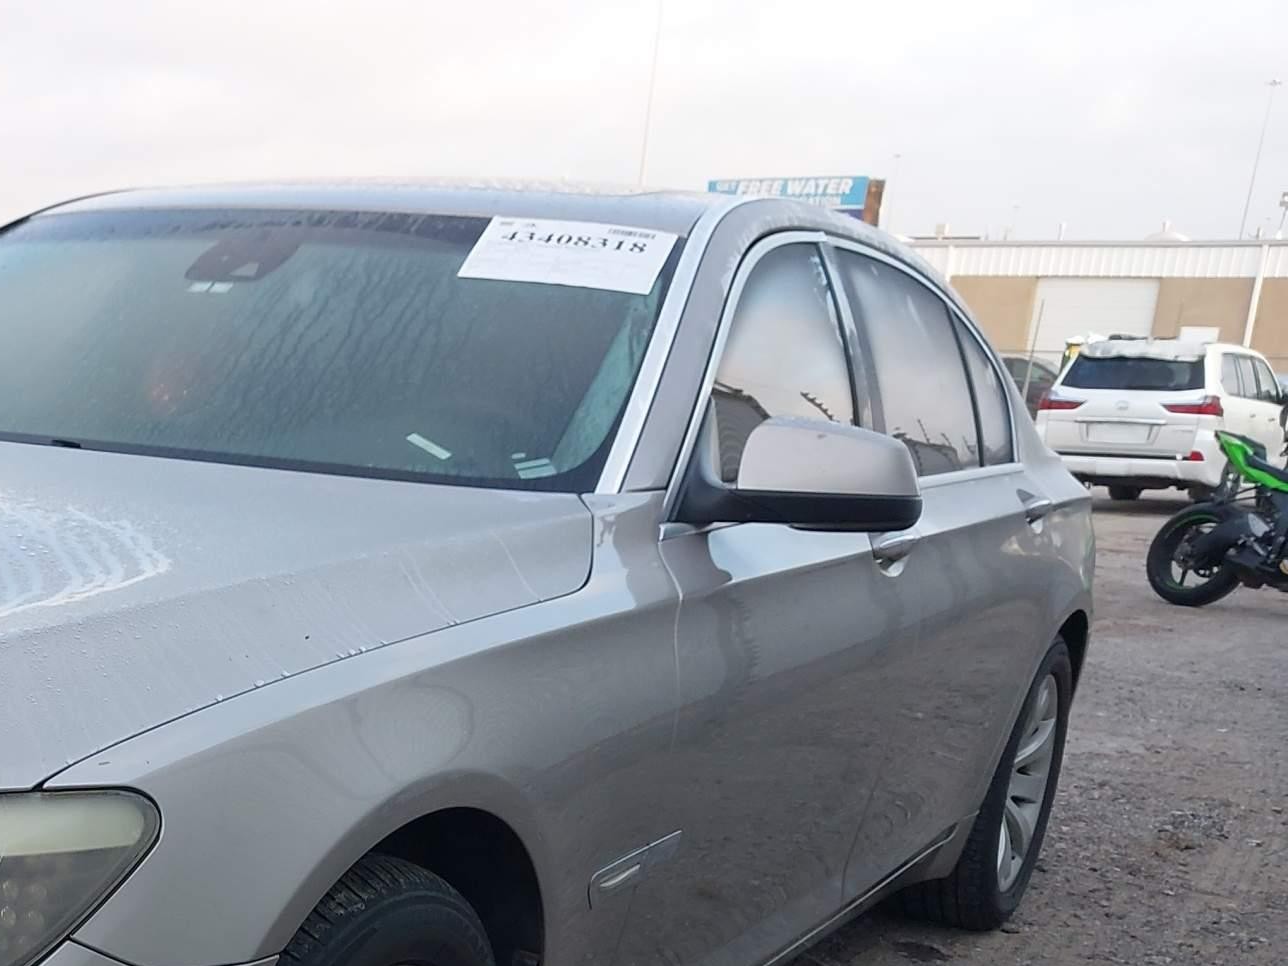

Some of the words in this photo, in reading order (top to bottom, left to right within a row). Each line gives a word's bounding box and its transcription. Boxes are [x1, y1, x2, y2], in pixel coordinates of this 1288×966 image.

[736, 180, 783, 198] FREE
[786, 178, 853, 195] WATER
[500, 228, 648, 254] 43408318
